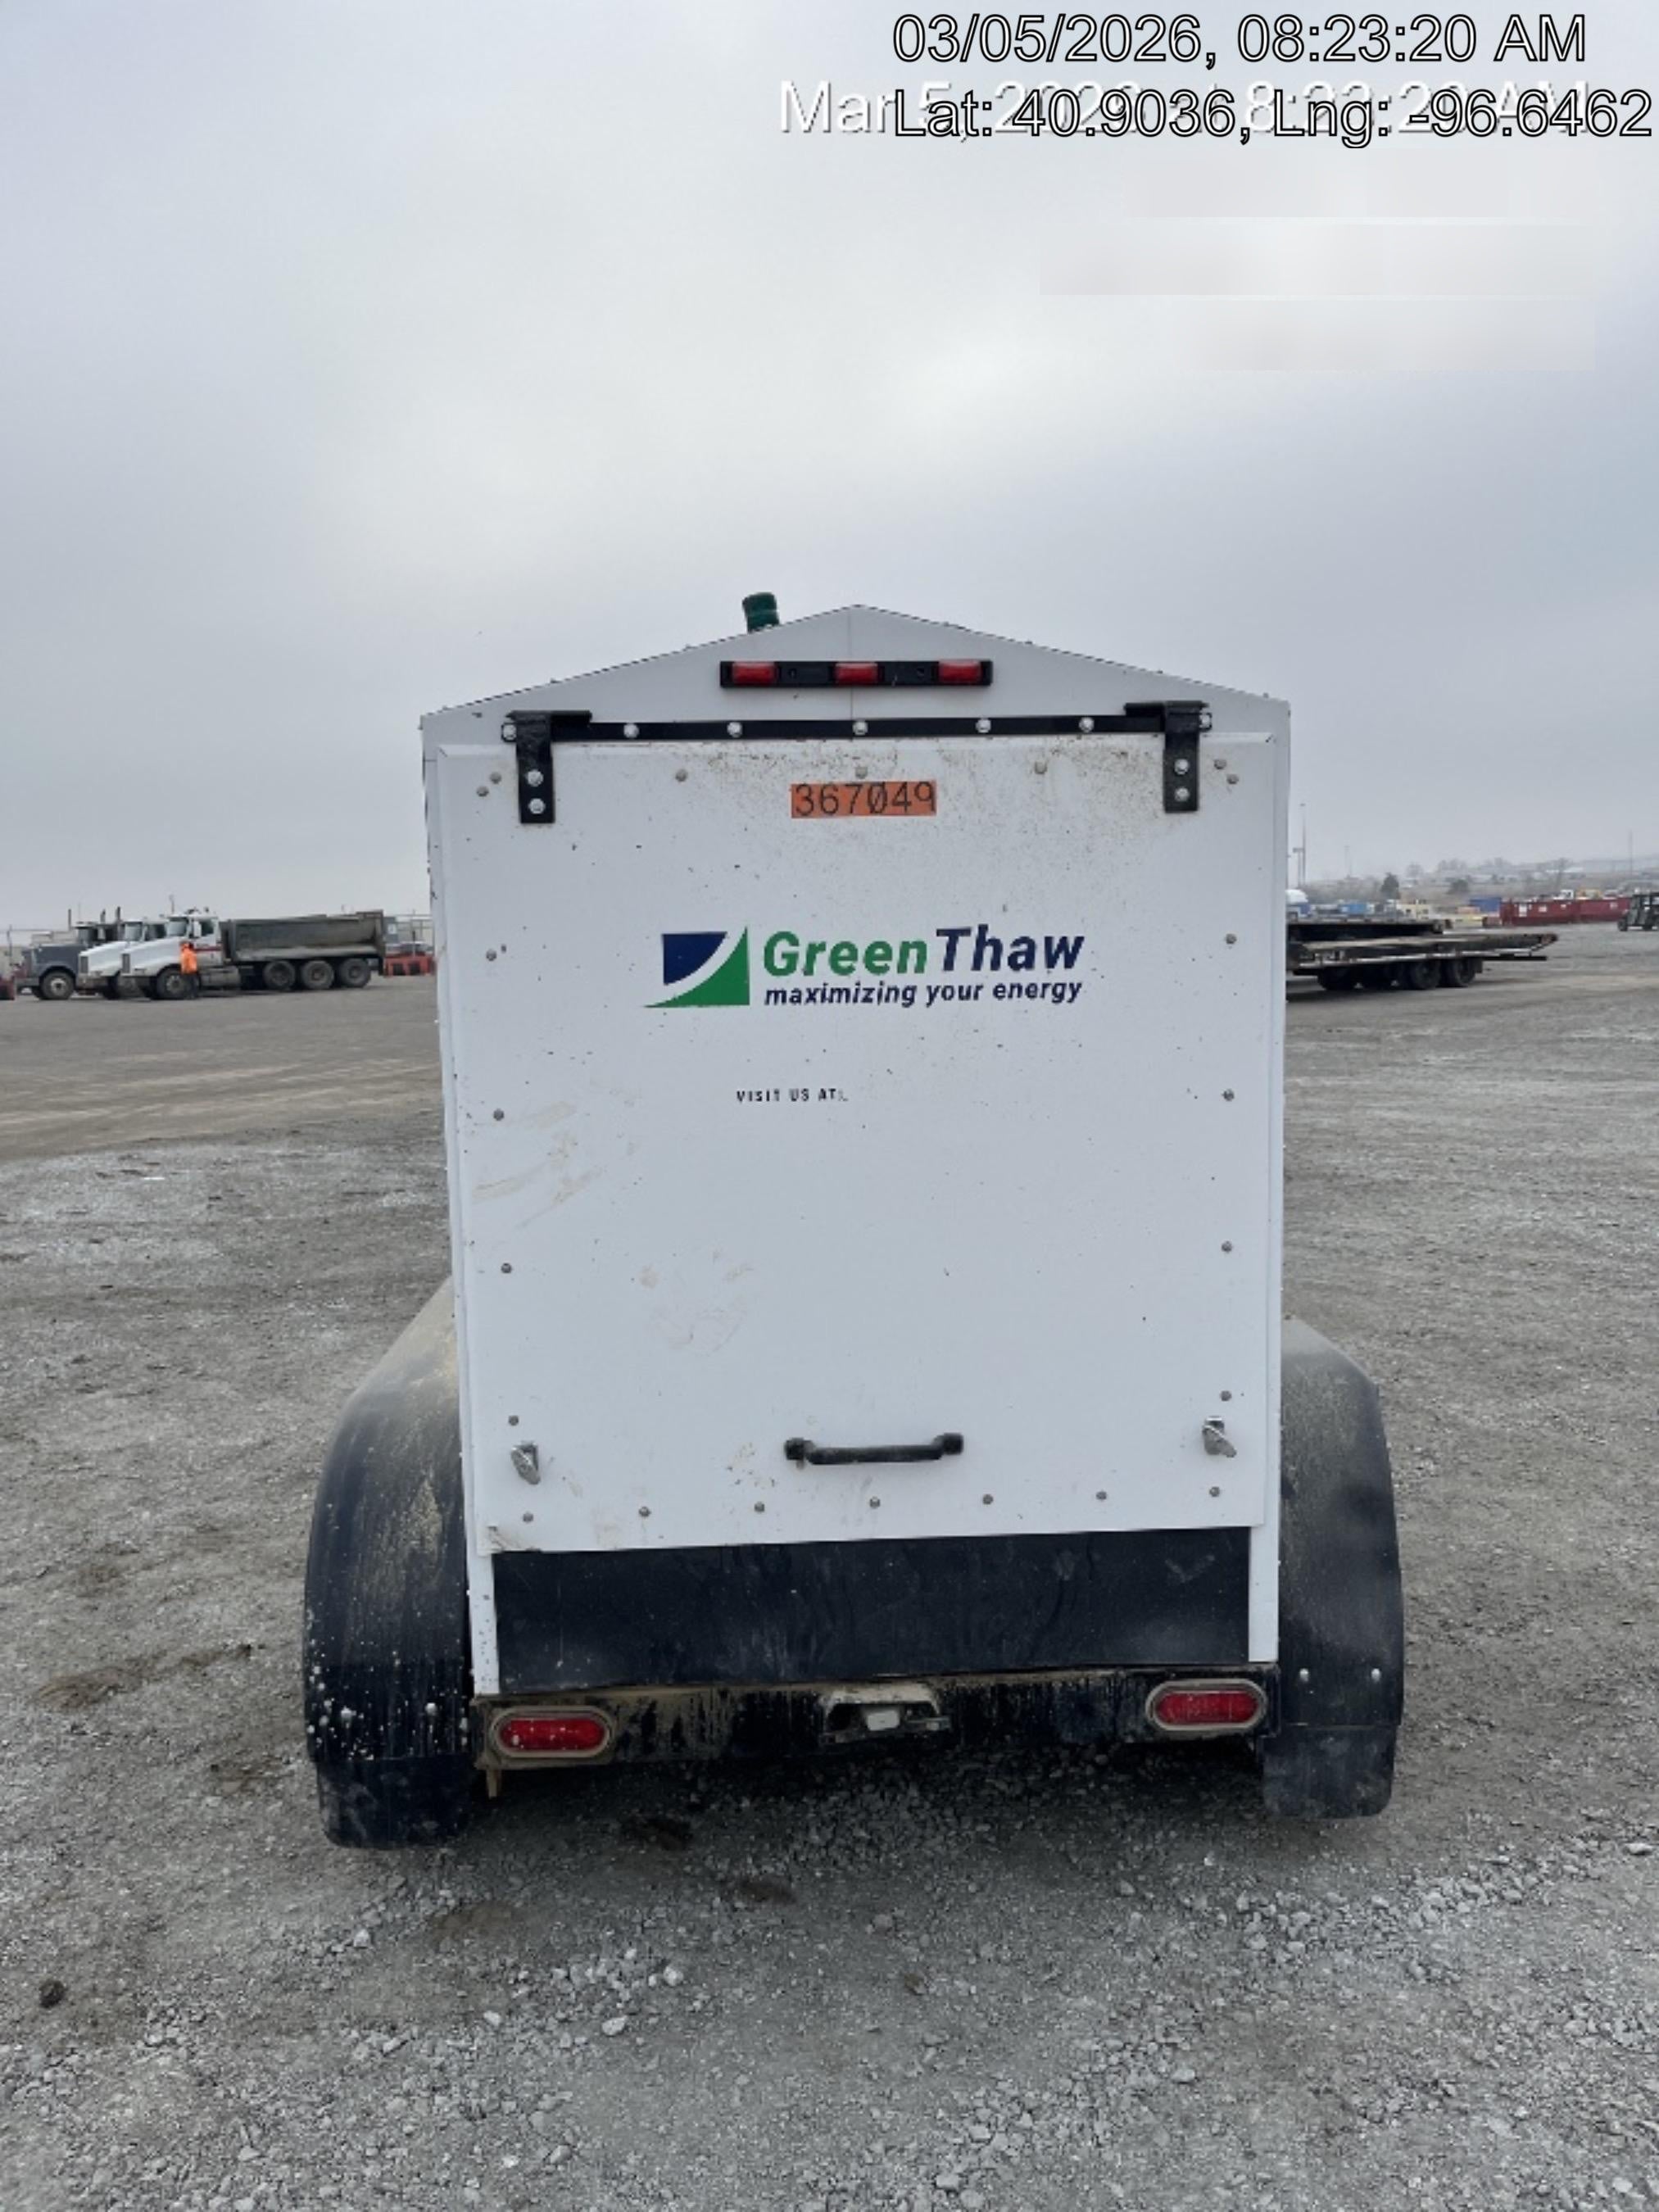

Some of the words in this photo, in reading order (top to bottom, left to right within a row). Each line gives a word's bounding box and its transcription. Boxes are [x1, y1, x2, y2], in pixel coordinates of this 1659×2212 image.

[796, 781, 936, 816] 367049
[764, 981, 918, 1008] maximizing
[925, 982, 985, 1007] your
[992, 981, 1083, 1004] energy
[736, 1090, 781, 1104] VISIT
[788, 1088, 810, 1103] US
